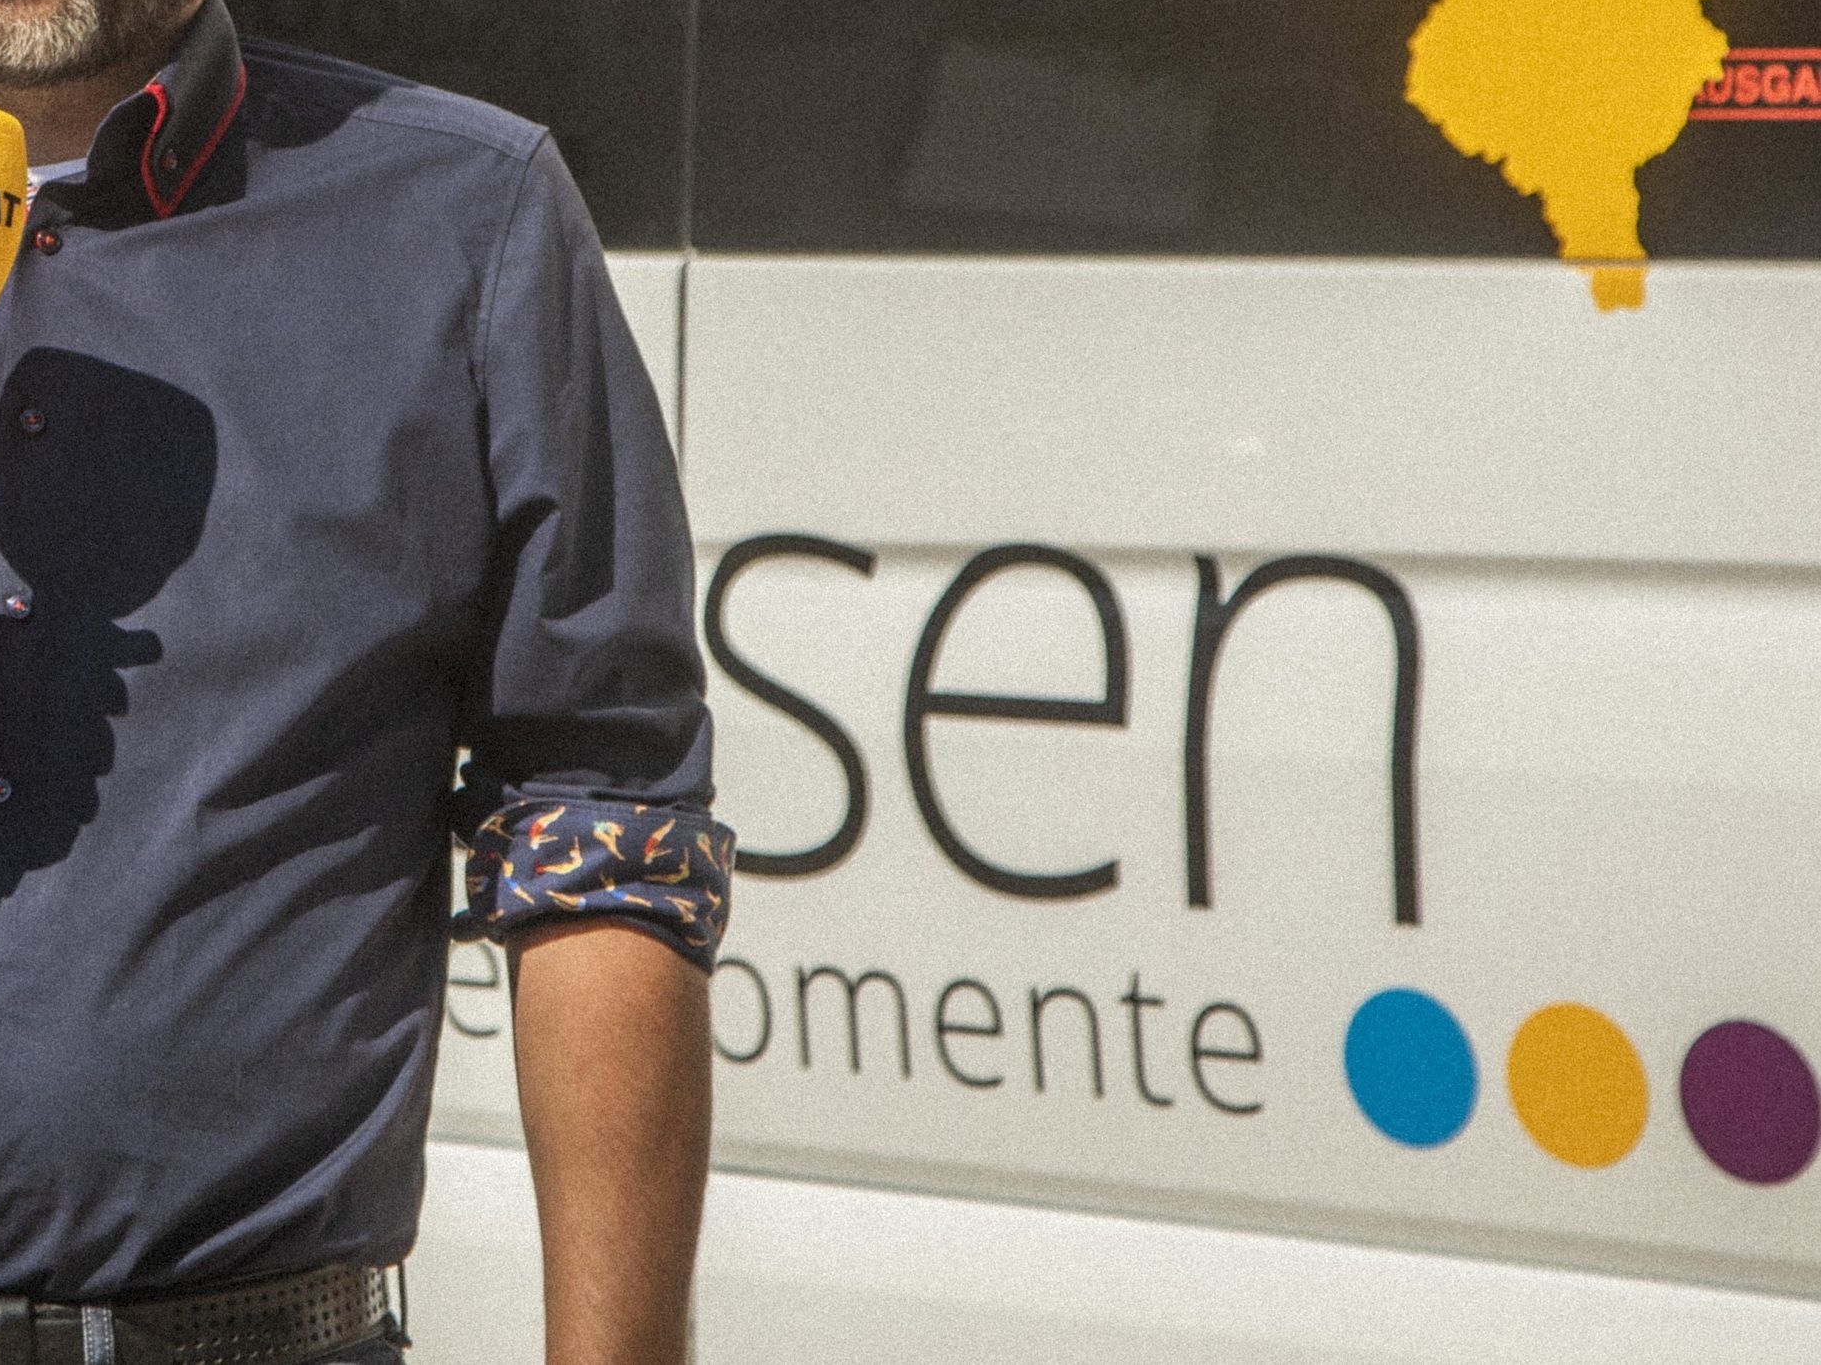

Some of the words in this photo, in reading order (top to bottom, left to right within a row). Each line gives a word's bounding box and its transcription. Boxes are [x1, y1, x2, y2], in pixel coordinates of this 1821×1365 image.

[1695, 64, 1821, 105] USGA
[704, 532, 1422, 927] sen
[713, 957, 1266, 1116] omente
